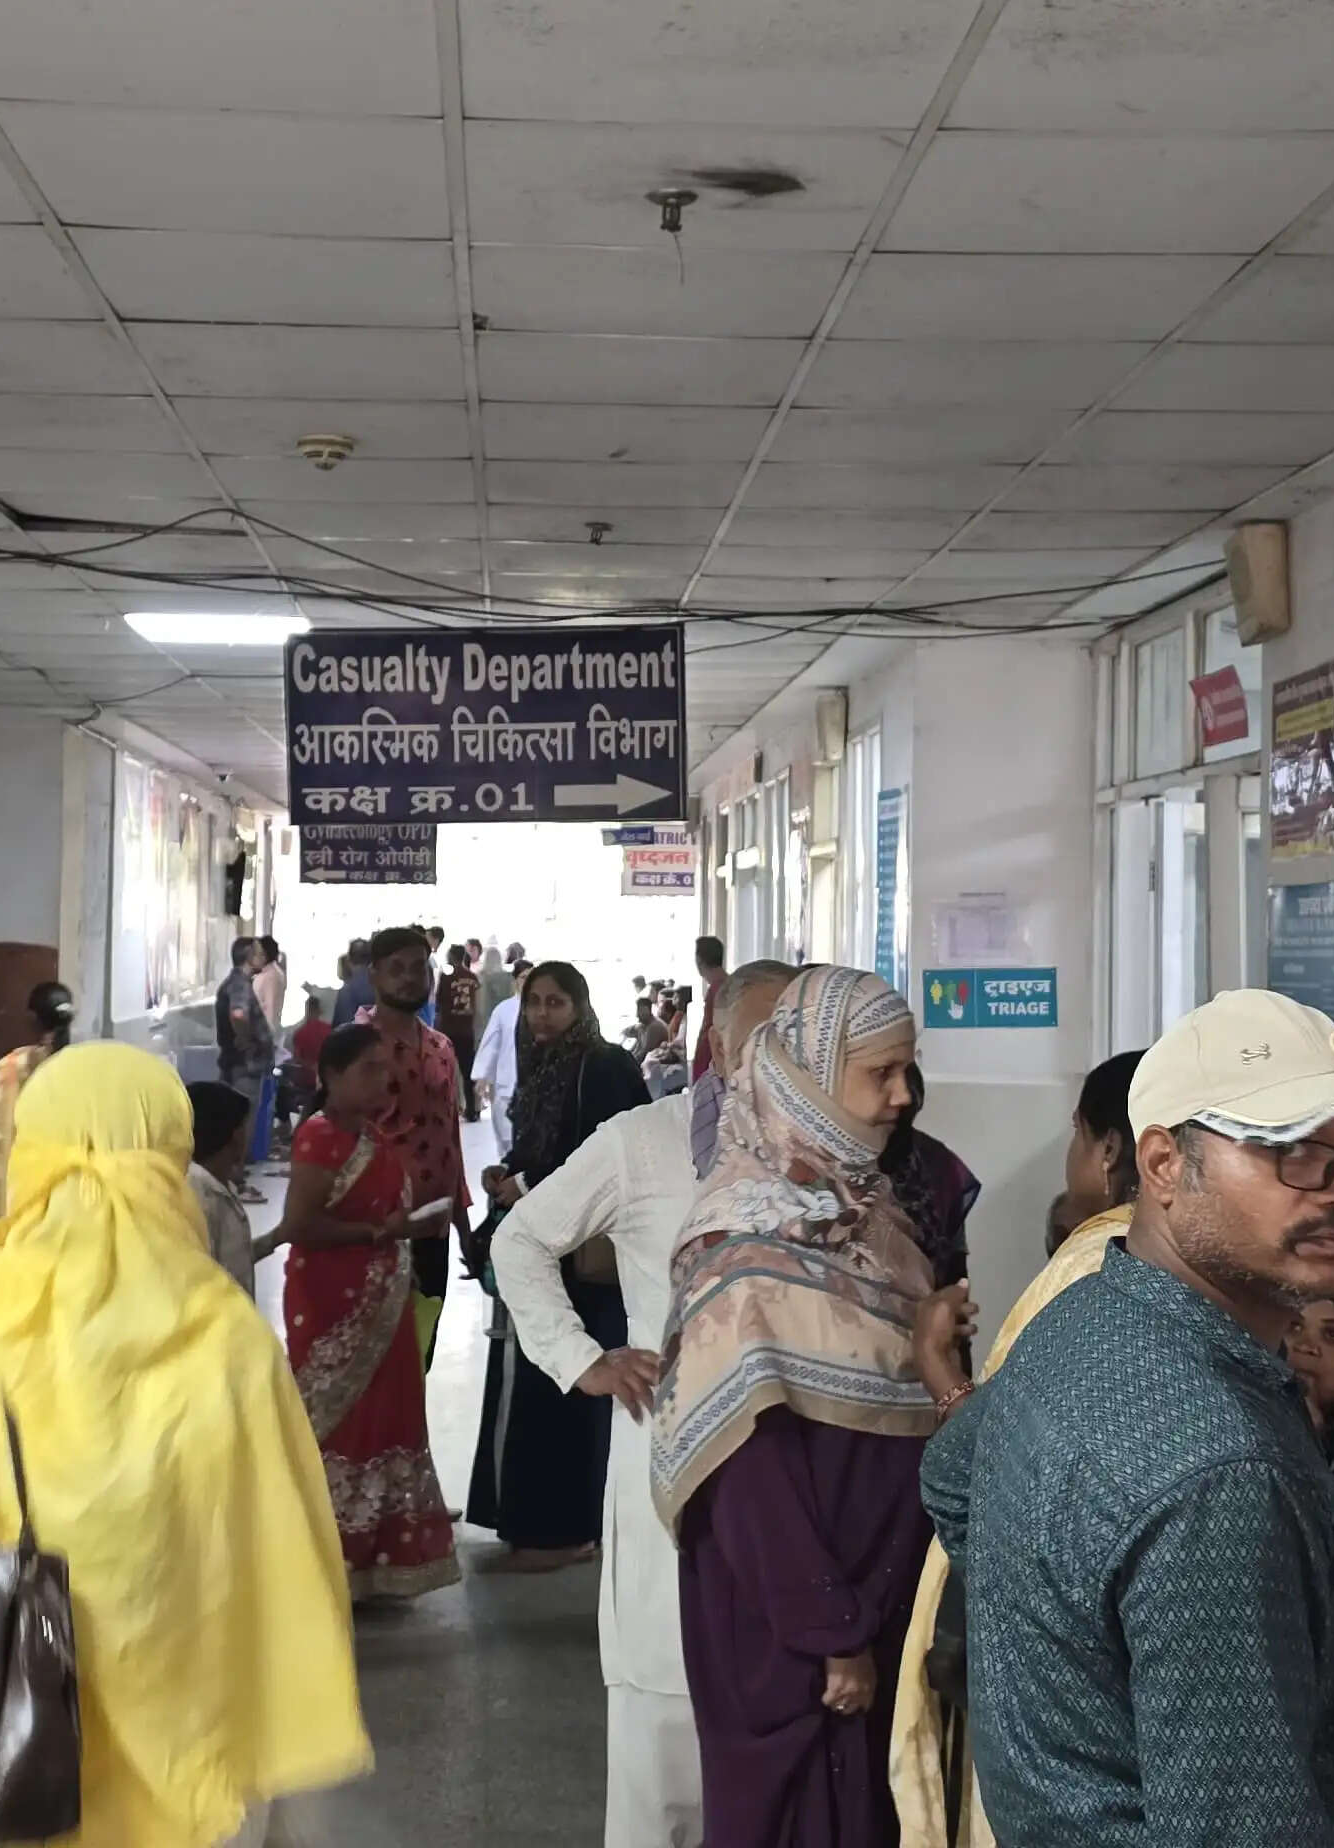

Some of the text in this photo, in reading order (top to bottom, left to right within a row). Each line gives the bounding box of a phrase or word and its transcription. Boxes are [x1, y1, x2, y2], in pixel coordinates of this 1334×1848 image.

[292, 640, 676, 705] Casualty Department
[293, 703, 678, 765] आकस्मिक चिकित्सा विभाग
[301, 786, 391, 816] कक्ष
[304, 845, 333, 866] स्त्री
[339, 846, 369, 866] रोग
[987, 1001, 1050, 1016] TRIAGE
